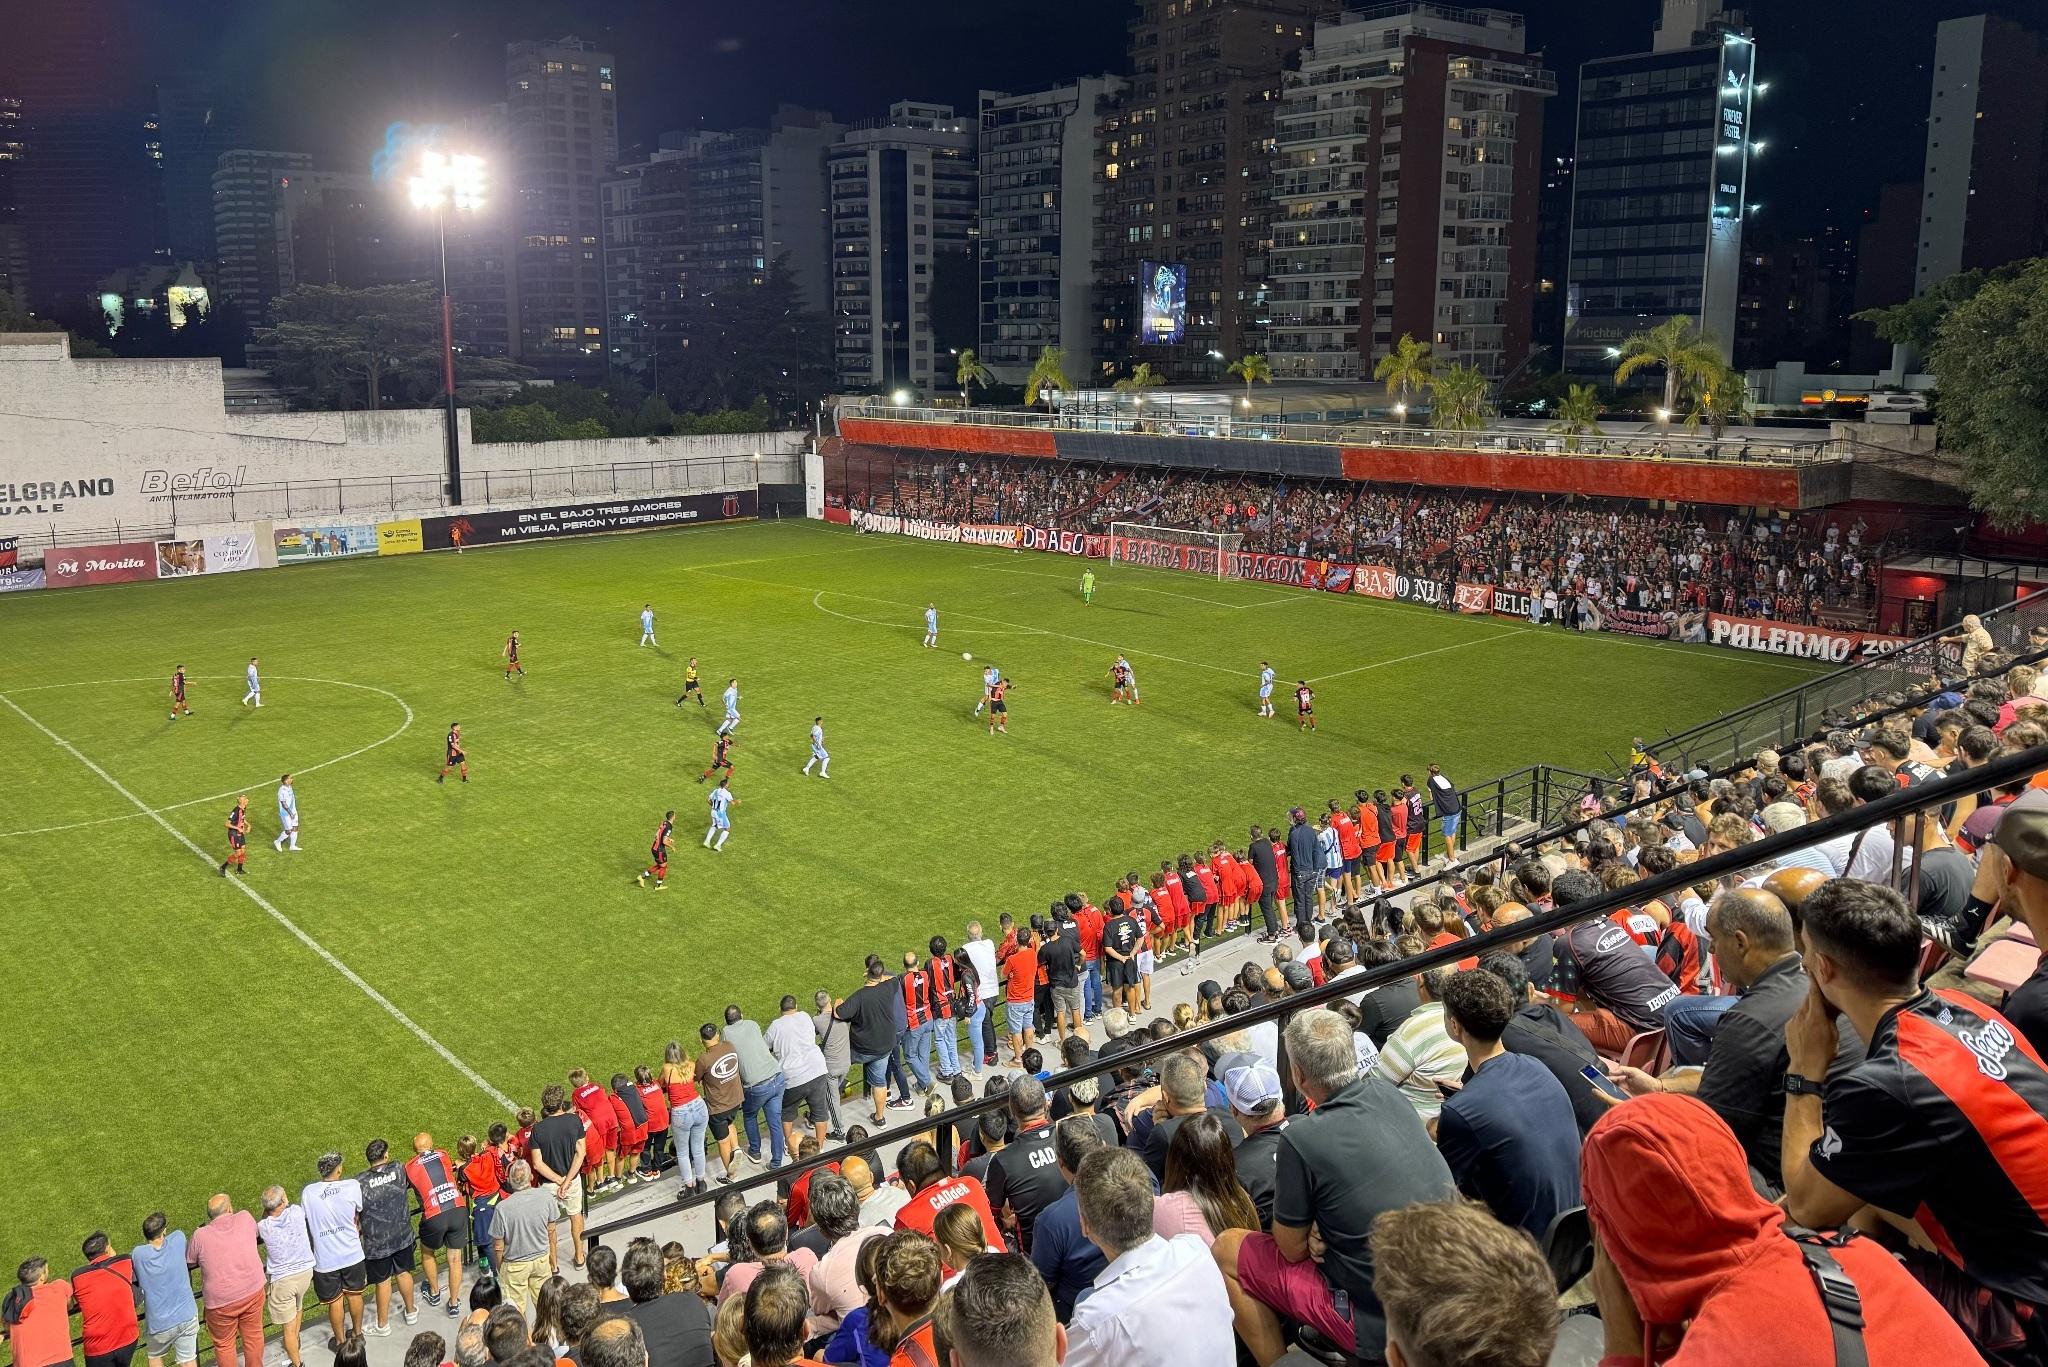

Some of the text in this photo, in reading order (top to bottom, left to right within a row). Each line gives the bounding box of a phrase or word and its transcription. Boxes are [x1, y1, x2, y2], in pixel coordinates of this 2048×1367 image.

[140, 465, 247, 494] Befol
[501, 510, 698, 537] MI VIEJA, PERÓN Y DEFENSORES
[518, 501, 682, 523] EN EL BAJO TRES AMORES
[850, 508, 902, 535] FORIDA
[962, 526, 1017, 546] SAAVEDR
[1023, 526, 1084, 555] DRAGO
[84, 558, 146, 573] Morita
[1127, 540, 1183, 570] BARRA
[1186, 545, 1220, 576] DEL
[1226, 551, 1306, 584] DRAGON
[1354, 566, 1488, 611] BAJO NUEZ
[1710, 618, 1851, 663] PALERMO
[1028, 1147, 1057, 1170] CAD
